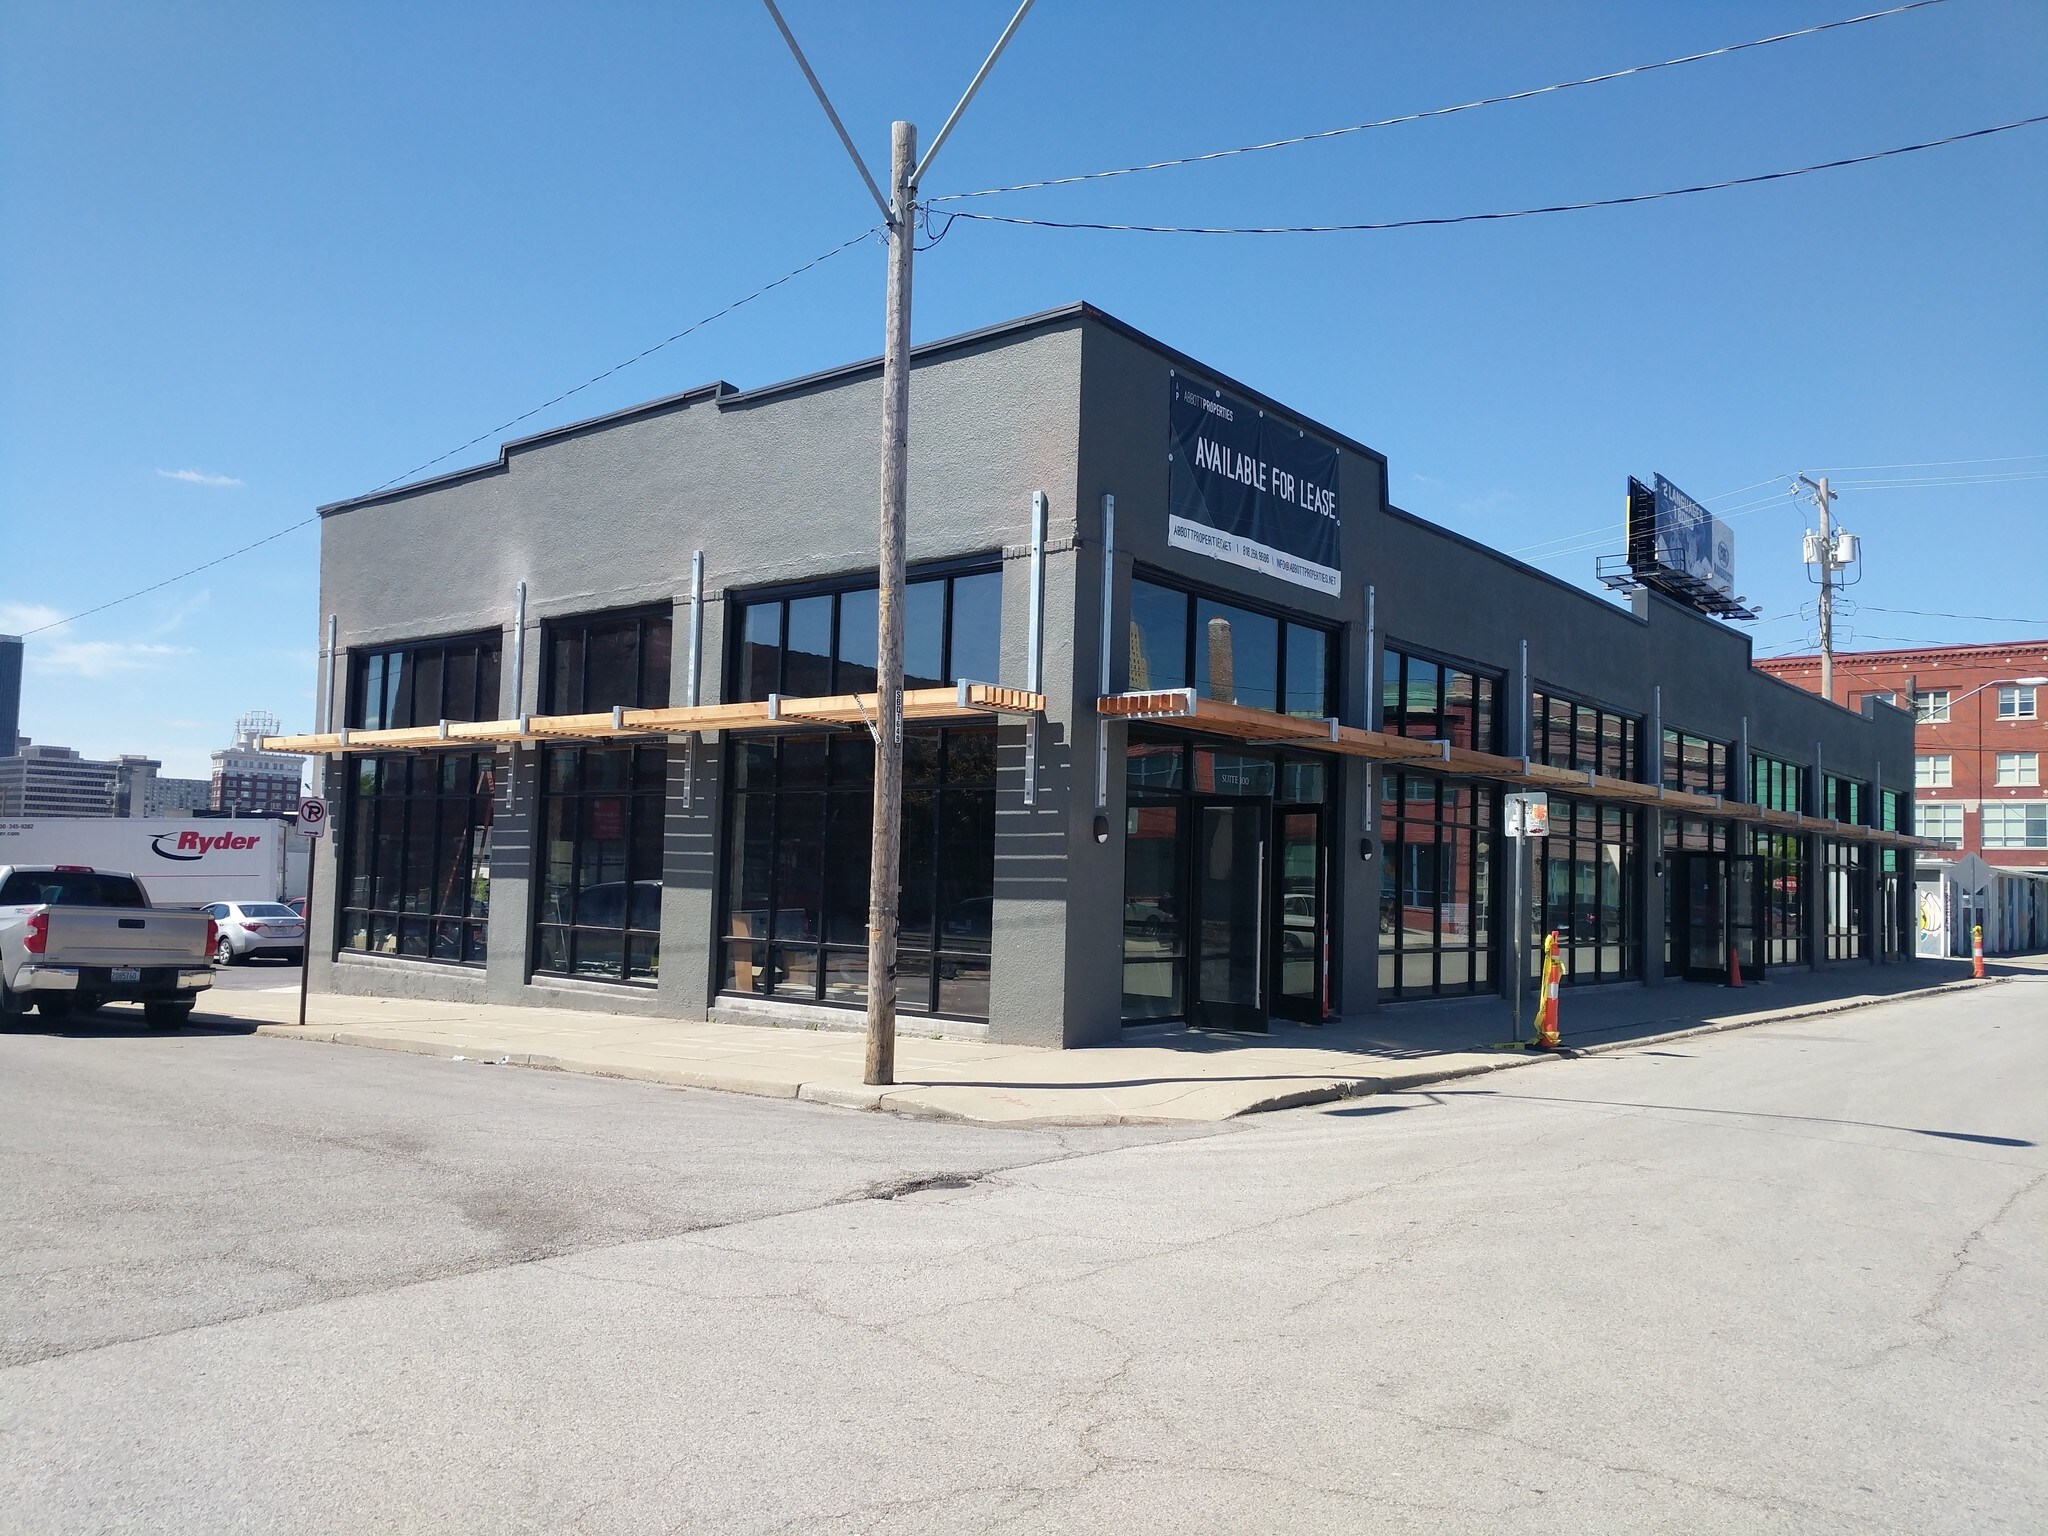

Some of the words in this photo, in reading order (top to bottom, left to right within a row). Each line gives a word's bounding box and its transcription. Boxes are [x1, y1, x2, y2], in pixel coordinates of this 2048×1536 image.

[1195, 436, 1267, 492] AVAILABLE
[1272, 467, 1295, 504] FOR
[1300, 479, 1336, 520] LEASE
[1173, 525, 1232, 551] ABBOTTPROPERTIESNET
[1221, 774, 1239, 785] SUITE
[177, 831, 261, 855] Ryder
